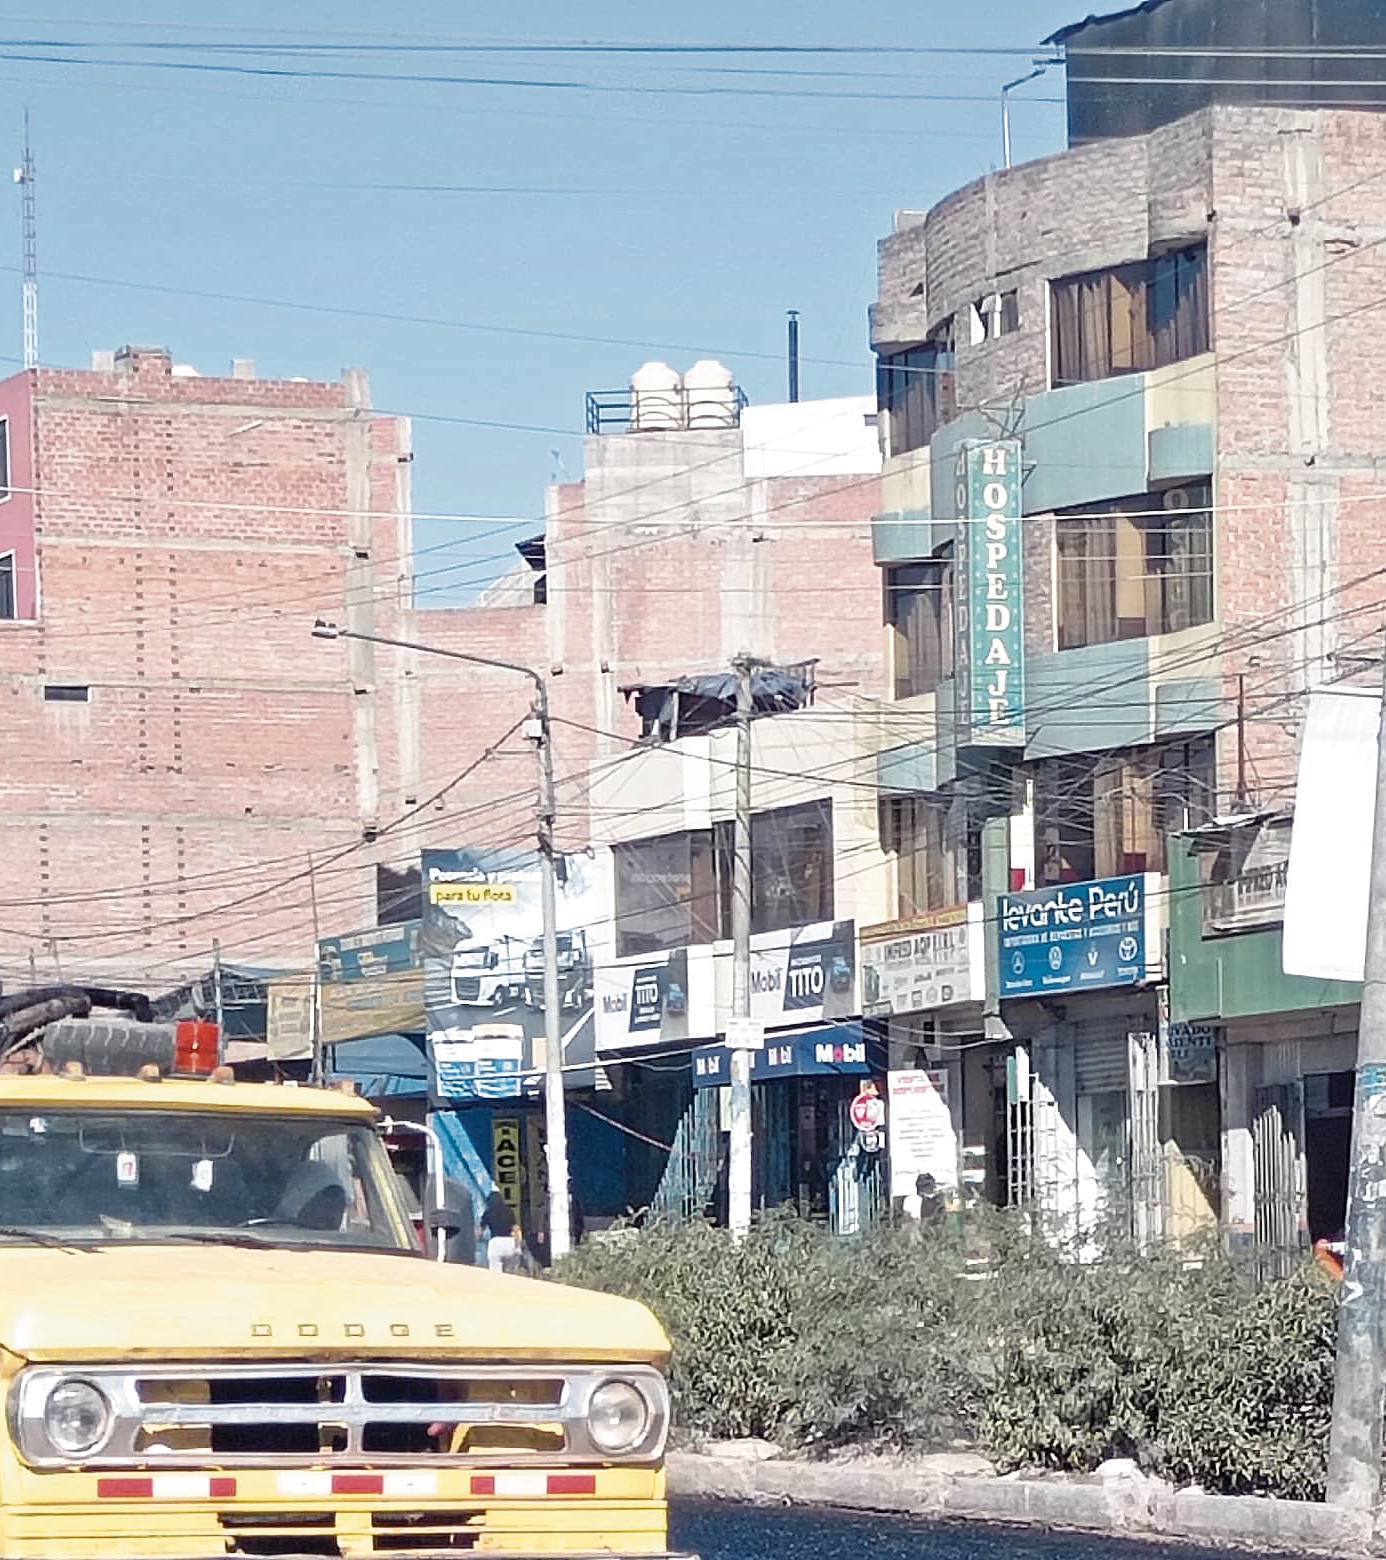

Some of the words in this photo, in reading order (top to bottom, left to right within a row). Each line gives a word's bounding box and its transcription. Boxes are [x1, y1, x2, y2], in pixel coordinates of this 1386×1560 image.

[982, 449, 1012, 726] HOSPEDAJE
[1002, 891, 1084, 931] levante
[1088, 881, 1139, 920] Perú
[751, 968, 783, 993] Mobil
[789, 964, 824, 997] TITO
[635, 983, 659, 1005] TITO
[816, 1043, 866, 1063] Mobil
[250, 1324, 456, 1337] DODGE
